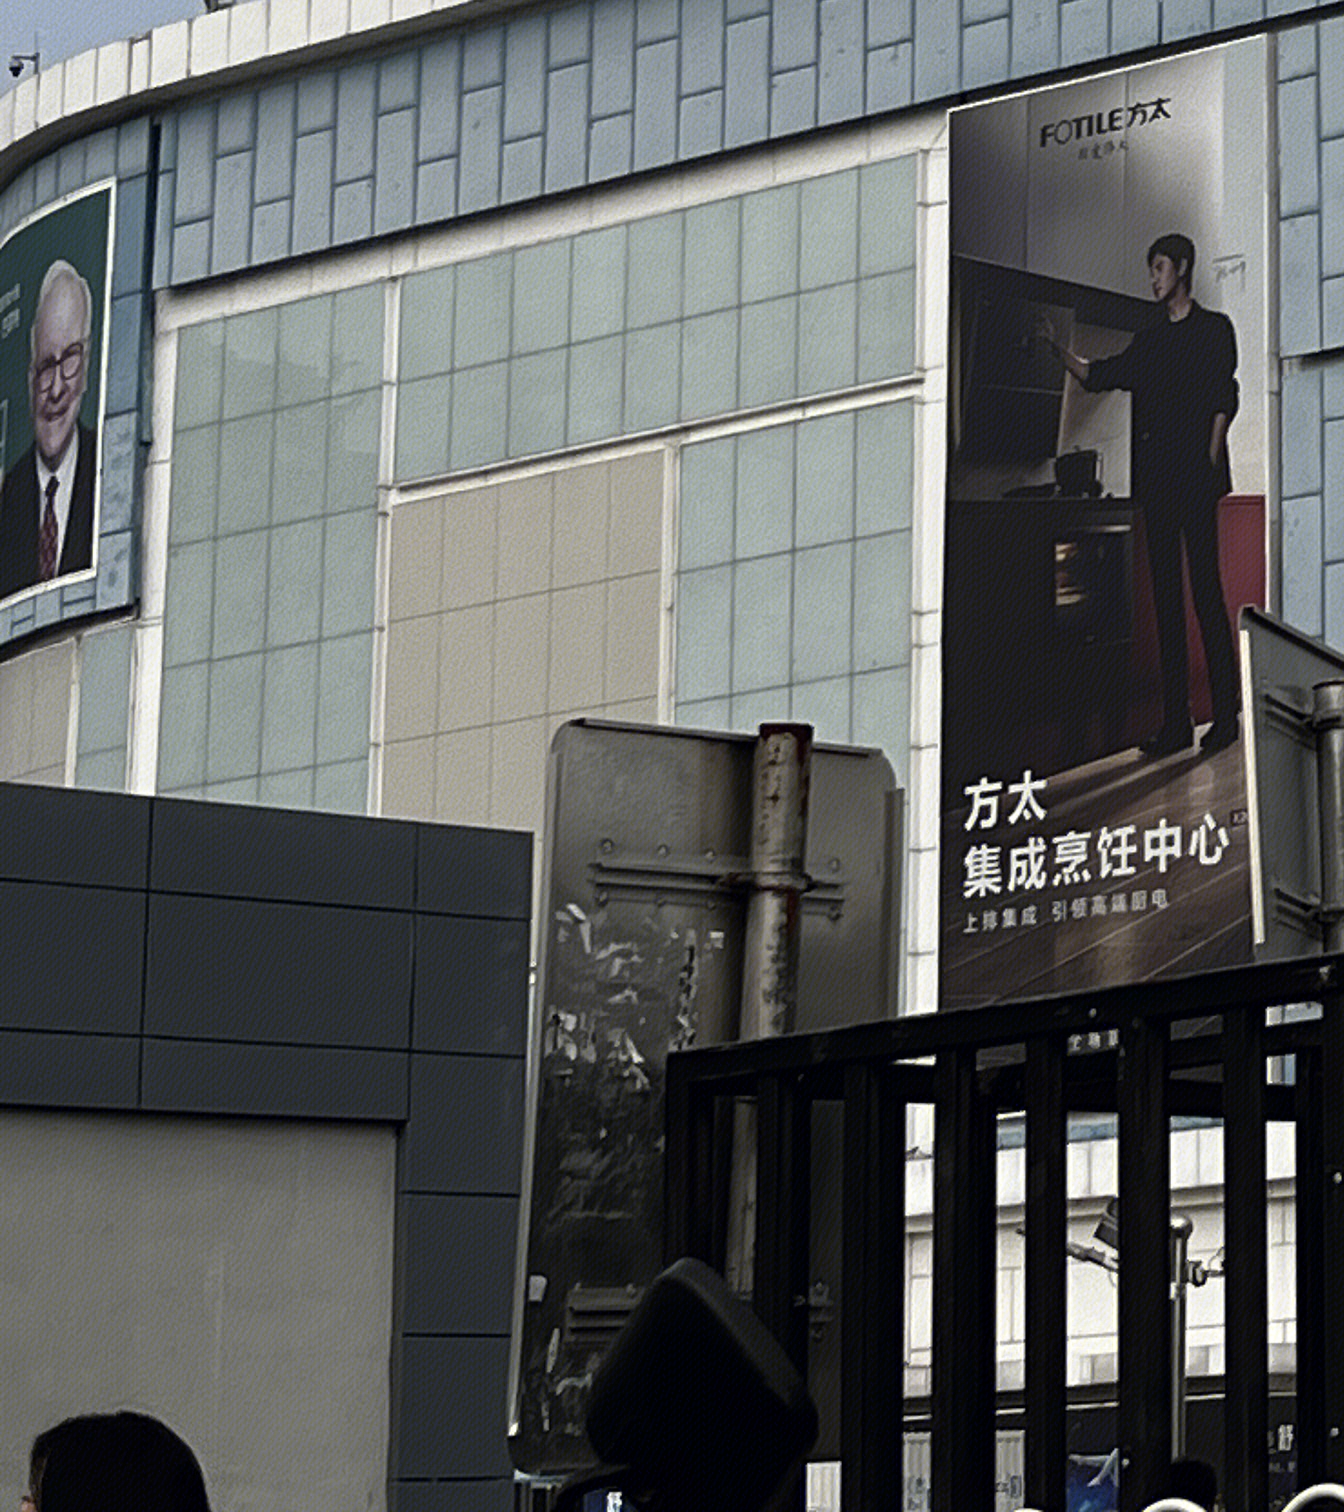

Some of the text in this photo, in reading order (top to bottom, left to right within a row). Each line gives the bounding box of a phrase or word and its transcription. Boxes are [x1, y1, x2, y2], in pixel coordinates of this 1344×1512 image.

[963, 769, 1048, 831] 方太
[962, 813, 1230, 899] 集成烹饪中心
